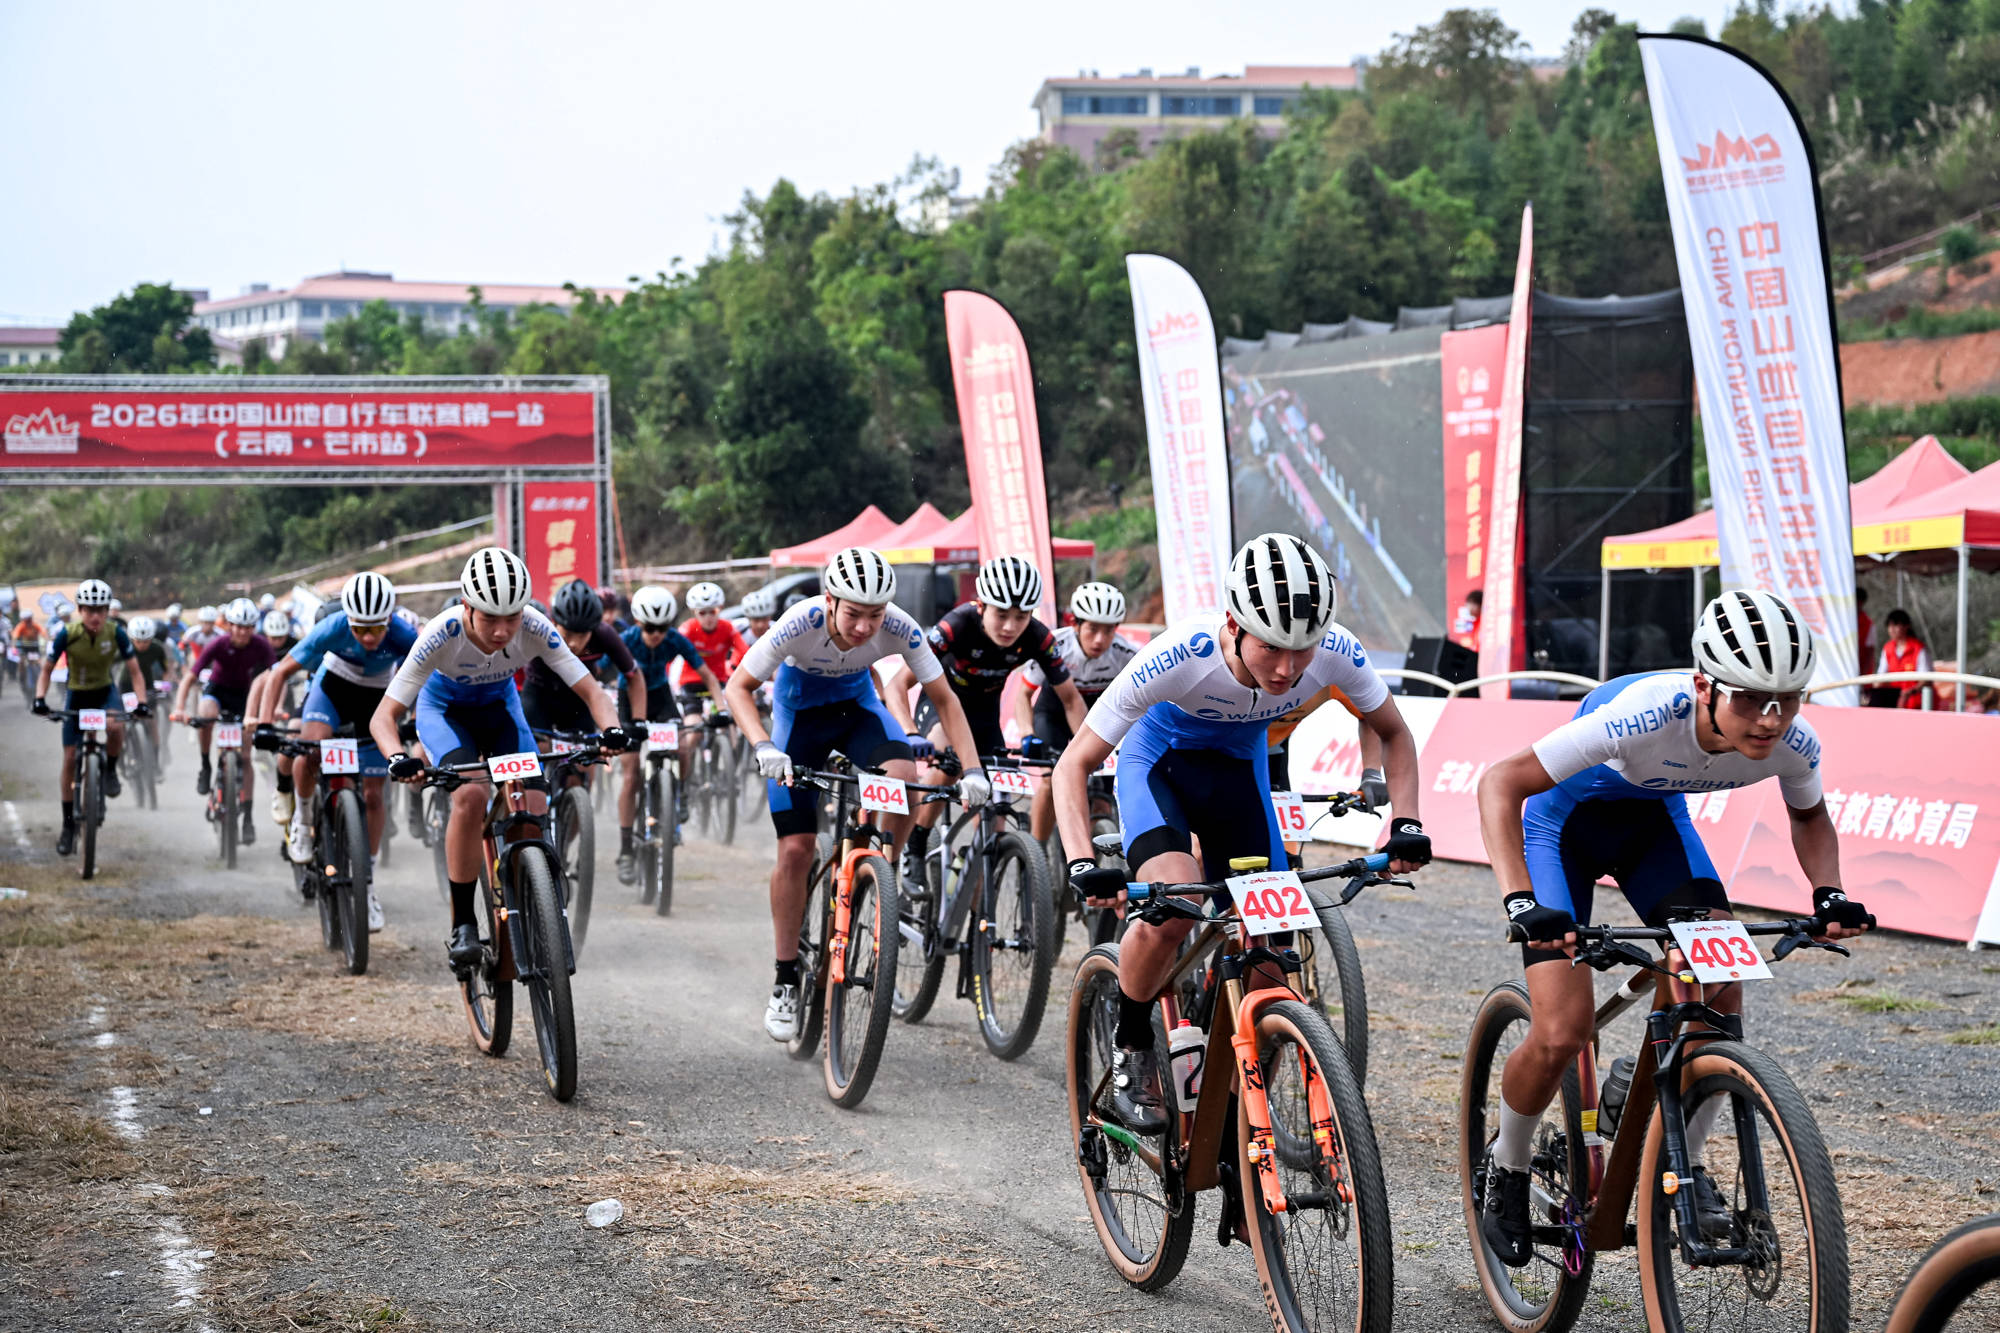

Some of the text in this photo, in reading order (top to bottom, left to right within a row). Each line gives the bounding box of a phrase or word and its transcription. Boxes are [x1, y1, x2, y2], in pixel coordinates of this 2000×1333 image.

[91, 402, 544, 428] 2026年中国山地自行车联赛第一站
[770, 615, 811, 650] WEIHAI
[413, 629, 450, 666] WEIHAI
[1131, 643, 1192, 688] WEIHAI
[1227, 698, 1301, 720] WEIHAI
[1605, 703, 1674, 740] WEIHAI
[325, 749, 354, 766] 411
[493, 758, 536, 775] 405
[993, 771, 1029, 788] 412
[862, 784, 904, 806] 404
[1243, 886, 1311, 920] 402
[1690, 936, 1758, 968] 403
